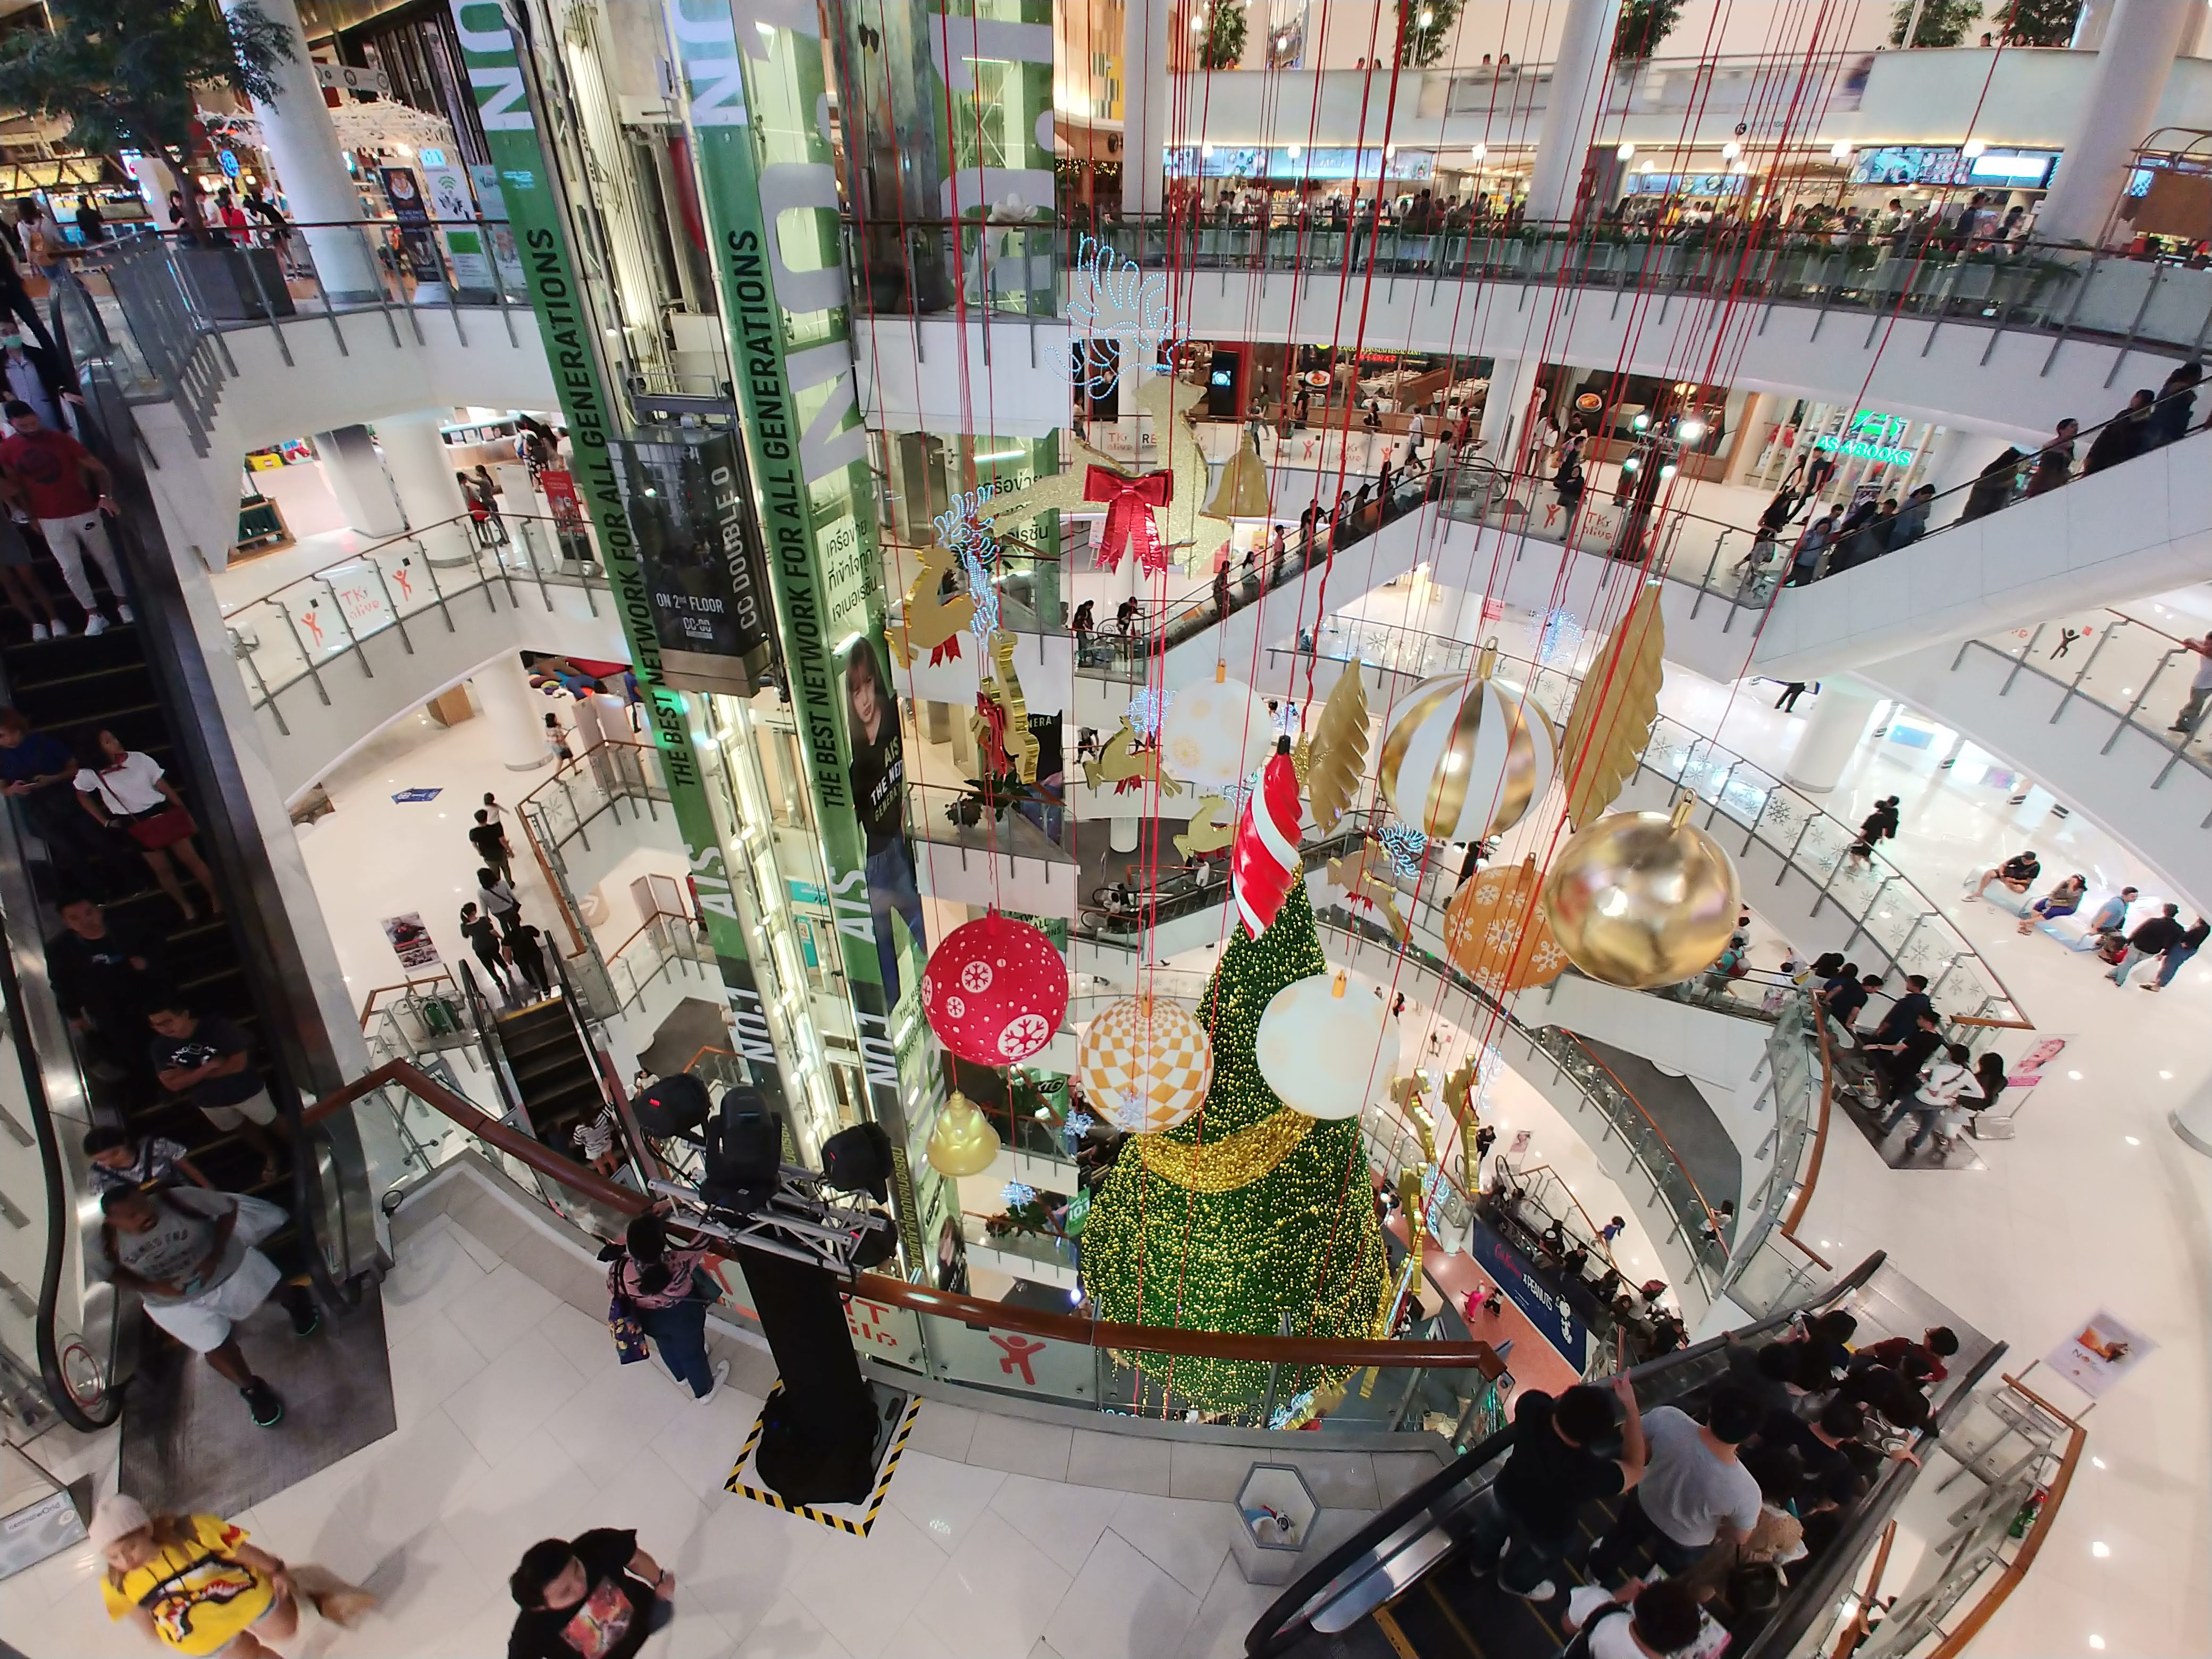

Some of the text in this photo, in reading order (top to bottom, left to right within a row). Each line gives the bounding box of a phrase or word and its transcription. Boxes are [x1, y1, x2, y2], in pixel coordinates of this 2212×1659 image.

[526, 229, 607, 447] GENERATIONS
[1853, 442, 1912, 465] BOOKS
[588, 456, 623, 505] ALL
[604, 513, 636, 561] FOR
[728, 229, 845, 808] THE BEST NETWORK FOR ALL GENERATIONS
[825, 518, 868, 558] เครือข่าย
[711, 466, 757, 630] CC DOUBLE O
[828, 547, 873, 592] ที่เข้าใจทุก
[656, 593, 672, 608] ON
[689, 596, 724, 613] FLOOR
[832, 574, 878, 623] เจเนอเรชัน
[618, 568, 665, 686] NETWORK
[652, 692, 684, 744] BEST
[668, 749, 694, 786] THE
[885, 735, 900, 768] AIS
[870, 776, 888, 807] THE
[684, 843, 738, 919] AIS
[828, 866, 876, 944] AIS
[725, 987, 777, 1063] NO.1
[857, 1011, 900, 1088] NO.1
[1527, 1275, 1553, 1312] PEANUTS
